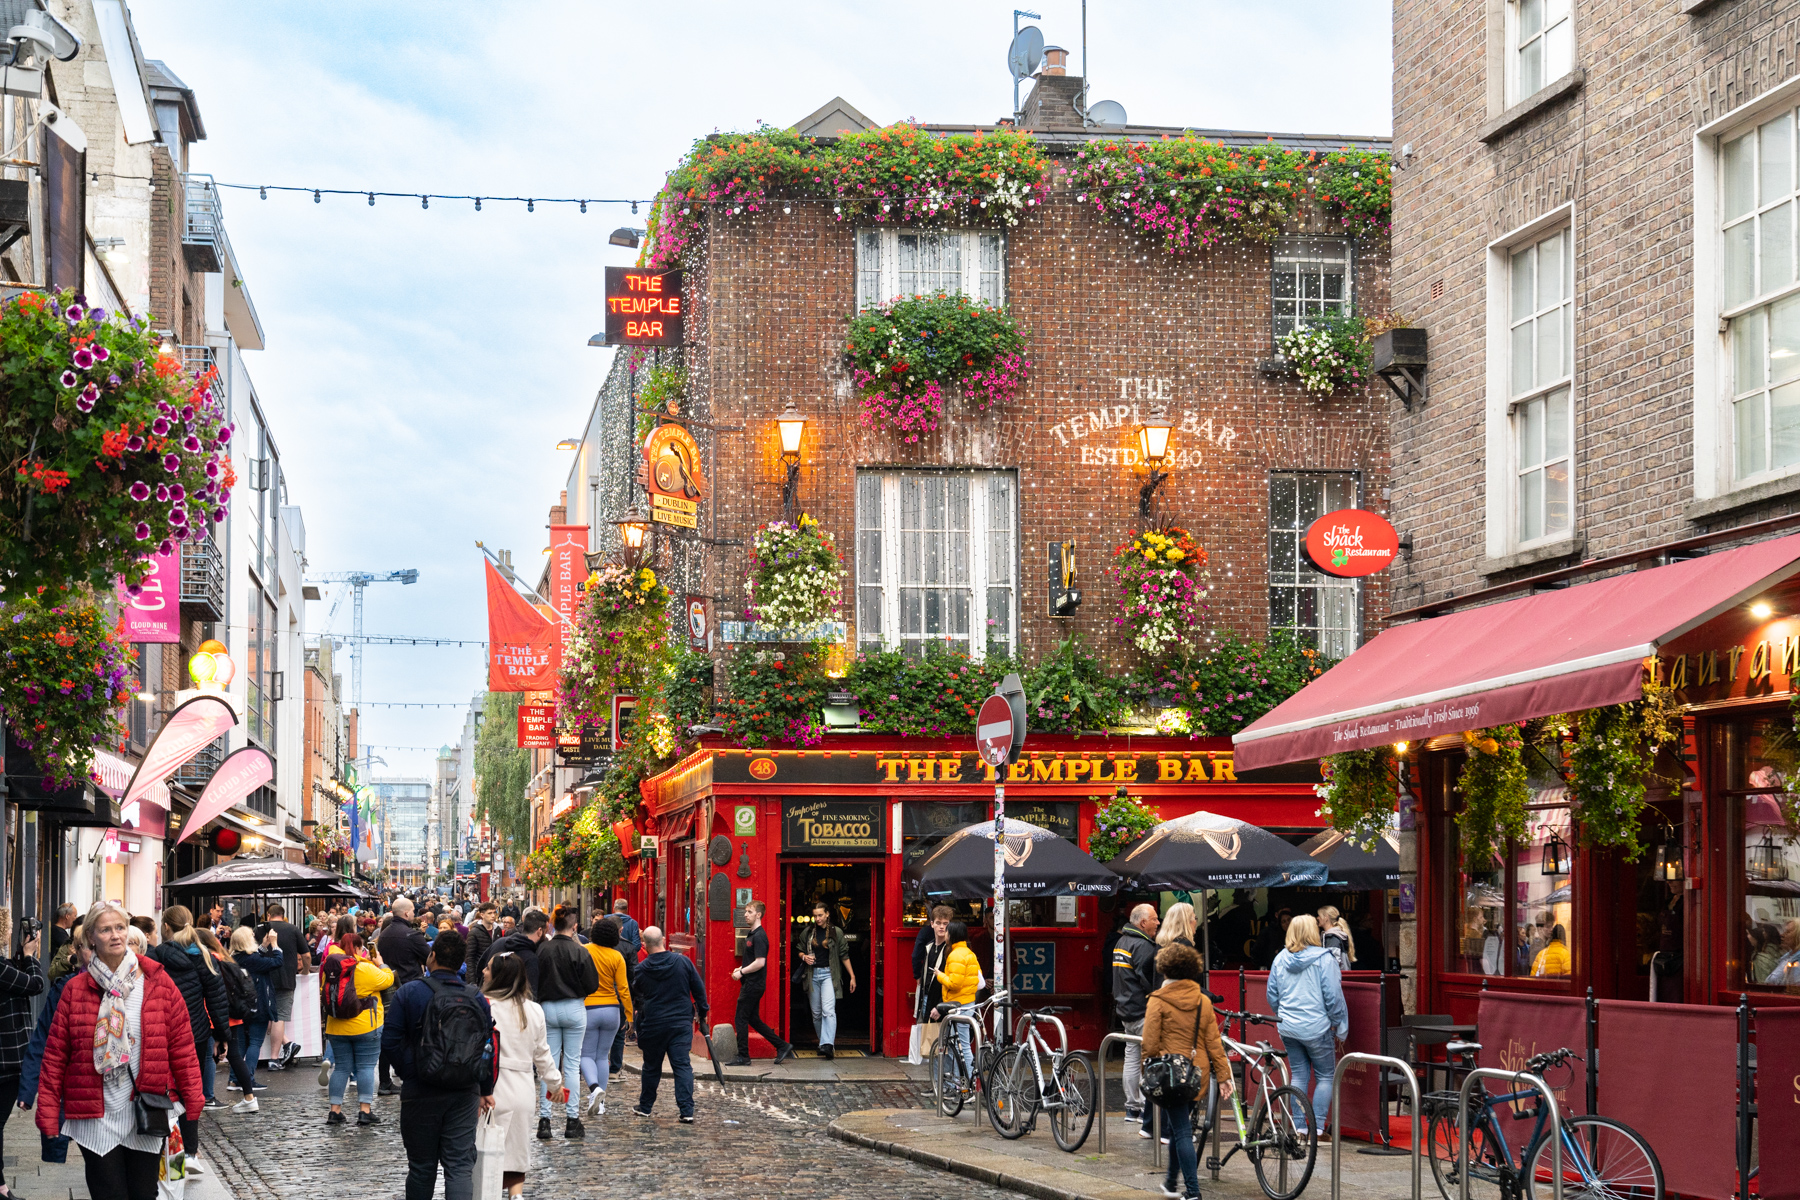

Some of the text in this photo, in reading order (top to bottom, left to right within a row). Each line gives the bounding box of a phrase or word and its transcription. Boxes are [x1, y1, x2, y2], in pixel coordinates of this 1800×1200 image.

[626, 276, 662, 291] THE
[609, 298, 679, 313] TEMPLE
[627, 321, 663, 337] BAR
[1117, 378, 1173, 400] THE
[1050, 405, 1236, 451] TEMPL BAR
[650, 428, 699, 473] THE TEMPLE BAR
[662, 498, 688, 509] DUBLIN
[657, 512, 694, 526] LIVE MUSIC
[1337, 524, 1350, 534] The
[1323, 525, 1363, 549] Shack
[1345, 548, 1391, 556] Restaurant
[560, 551, 571, 580] BAR
[130, 621, 167, 630] CLOUD NINE
[510, 647, 532, 655] THE
[495, 655, 549, 665] TEMPLE
[508, 666, 536, 675] BAR
[1333, 726, 1342, 742] The
[1344, 723, 1358, 741] Shack
[1360, 722, 1389, 737] Restaurant
[1395, 709, 1432, 731] Traditionally
[1434, 705, 1447, 723] Irish
[1448, 706, 1463, 720] Since
[1465, 702, 1479, 719] 1996
[153, 729, 194, 766] CLOUD
[754, 761, 771, 775] 48
[879, 758, 1237, 782] THE TEMPLE BAR
[207, 757, 266, 803] CLOUD NINE
[786, 802, 827, 818] Importers
[1013, 814, 1069, 826] EMPLE BAR
[1077, 883, 1112, 892] GUINNESS
[1514, 1038, 1525, 1055] The
